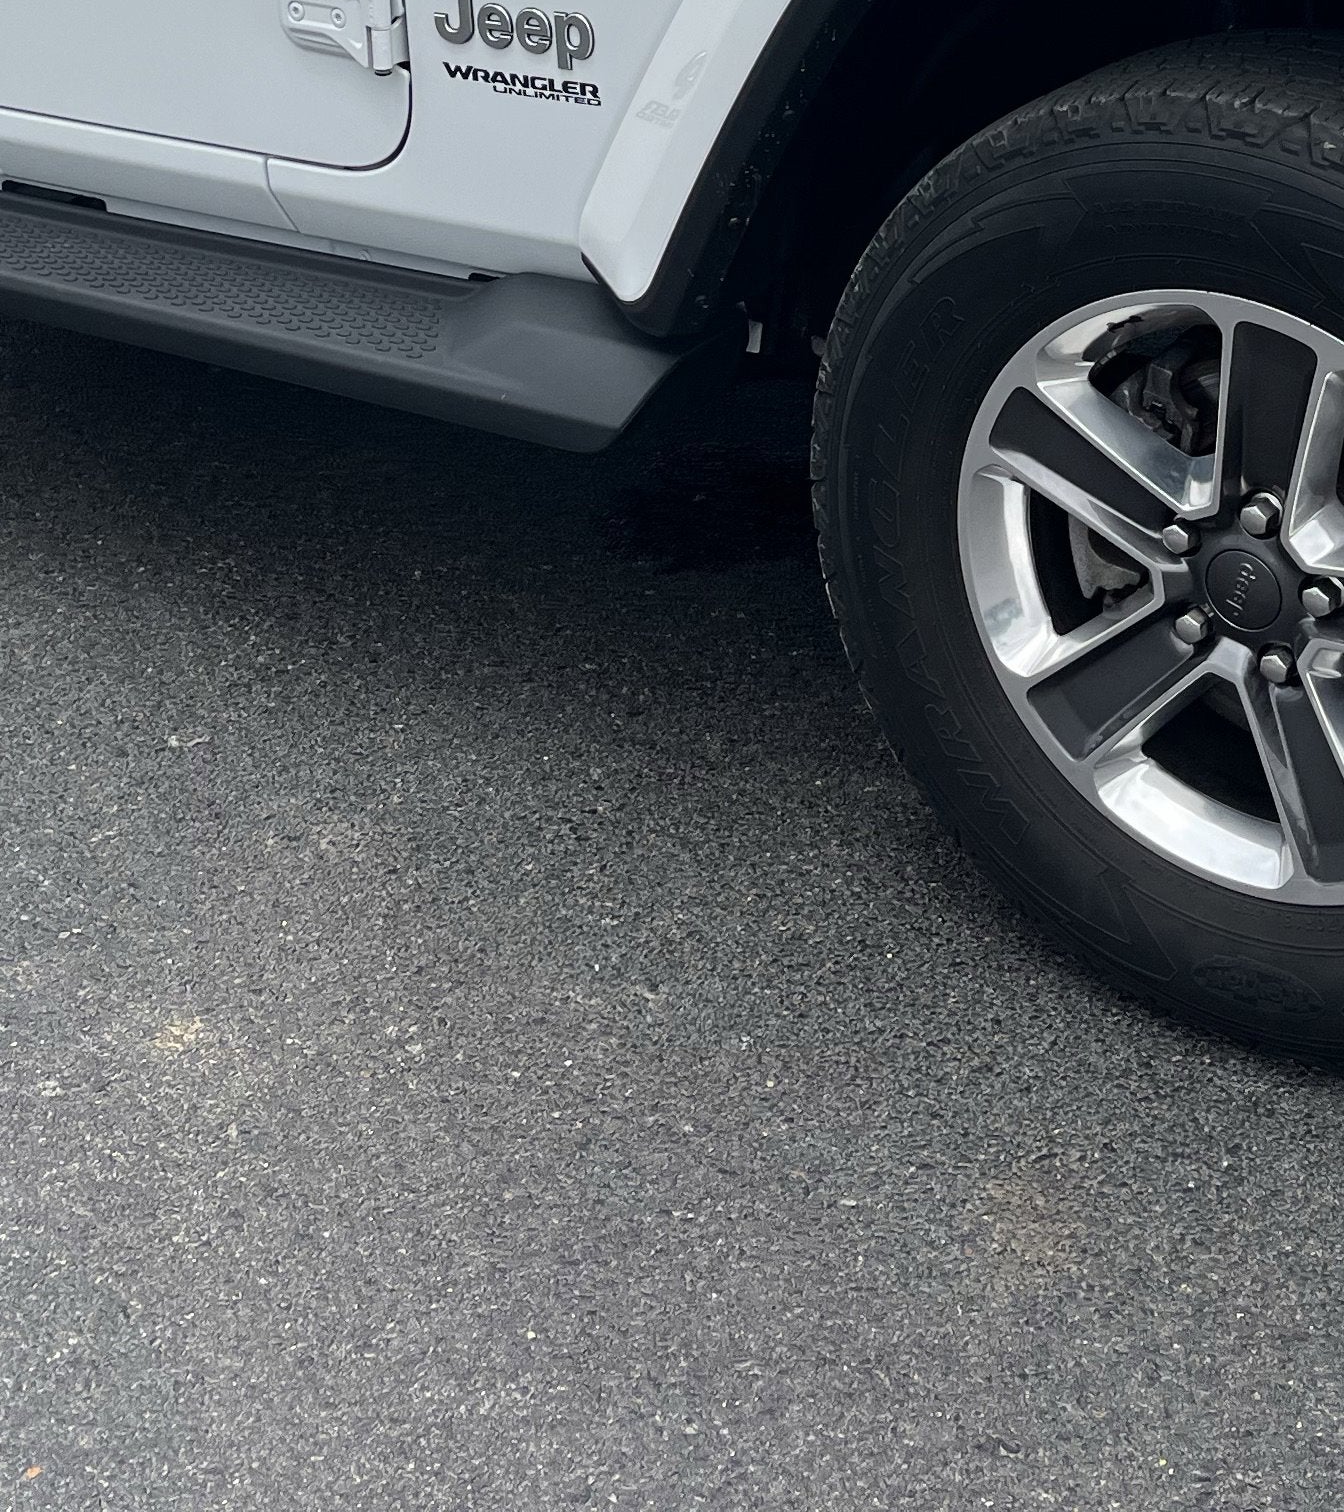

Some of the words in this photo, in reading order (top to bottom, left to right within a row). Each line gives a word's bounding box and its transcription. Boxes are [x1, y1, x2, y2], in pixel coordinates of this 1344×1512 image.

[442, 60, 601, 100] WRANGLER
[492, 84, 602, 107] UNLIMITED
[870, 294, 1033, 848] WRANGLER
